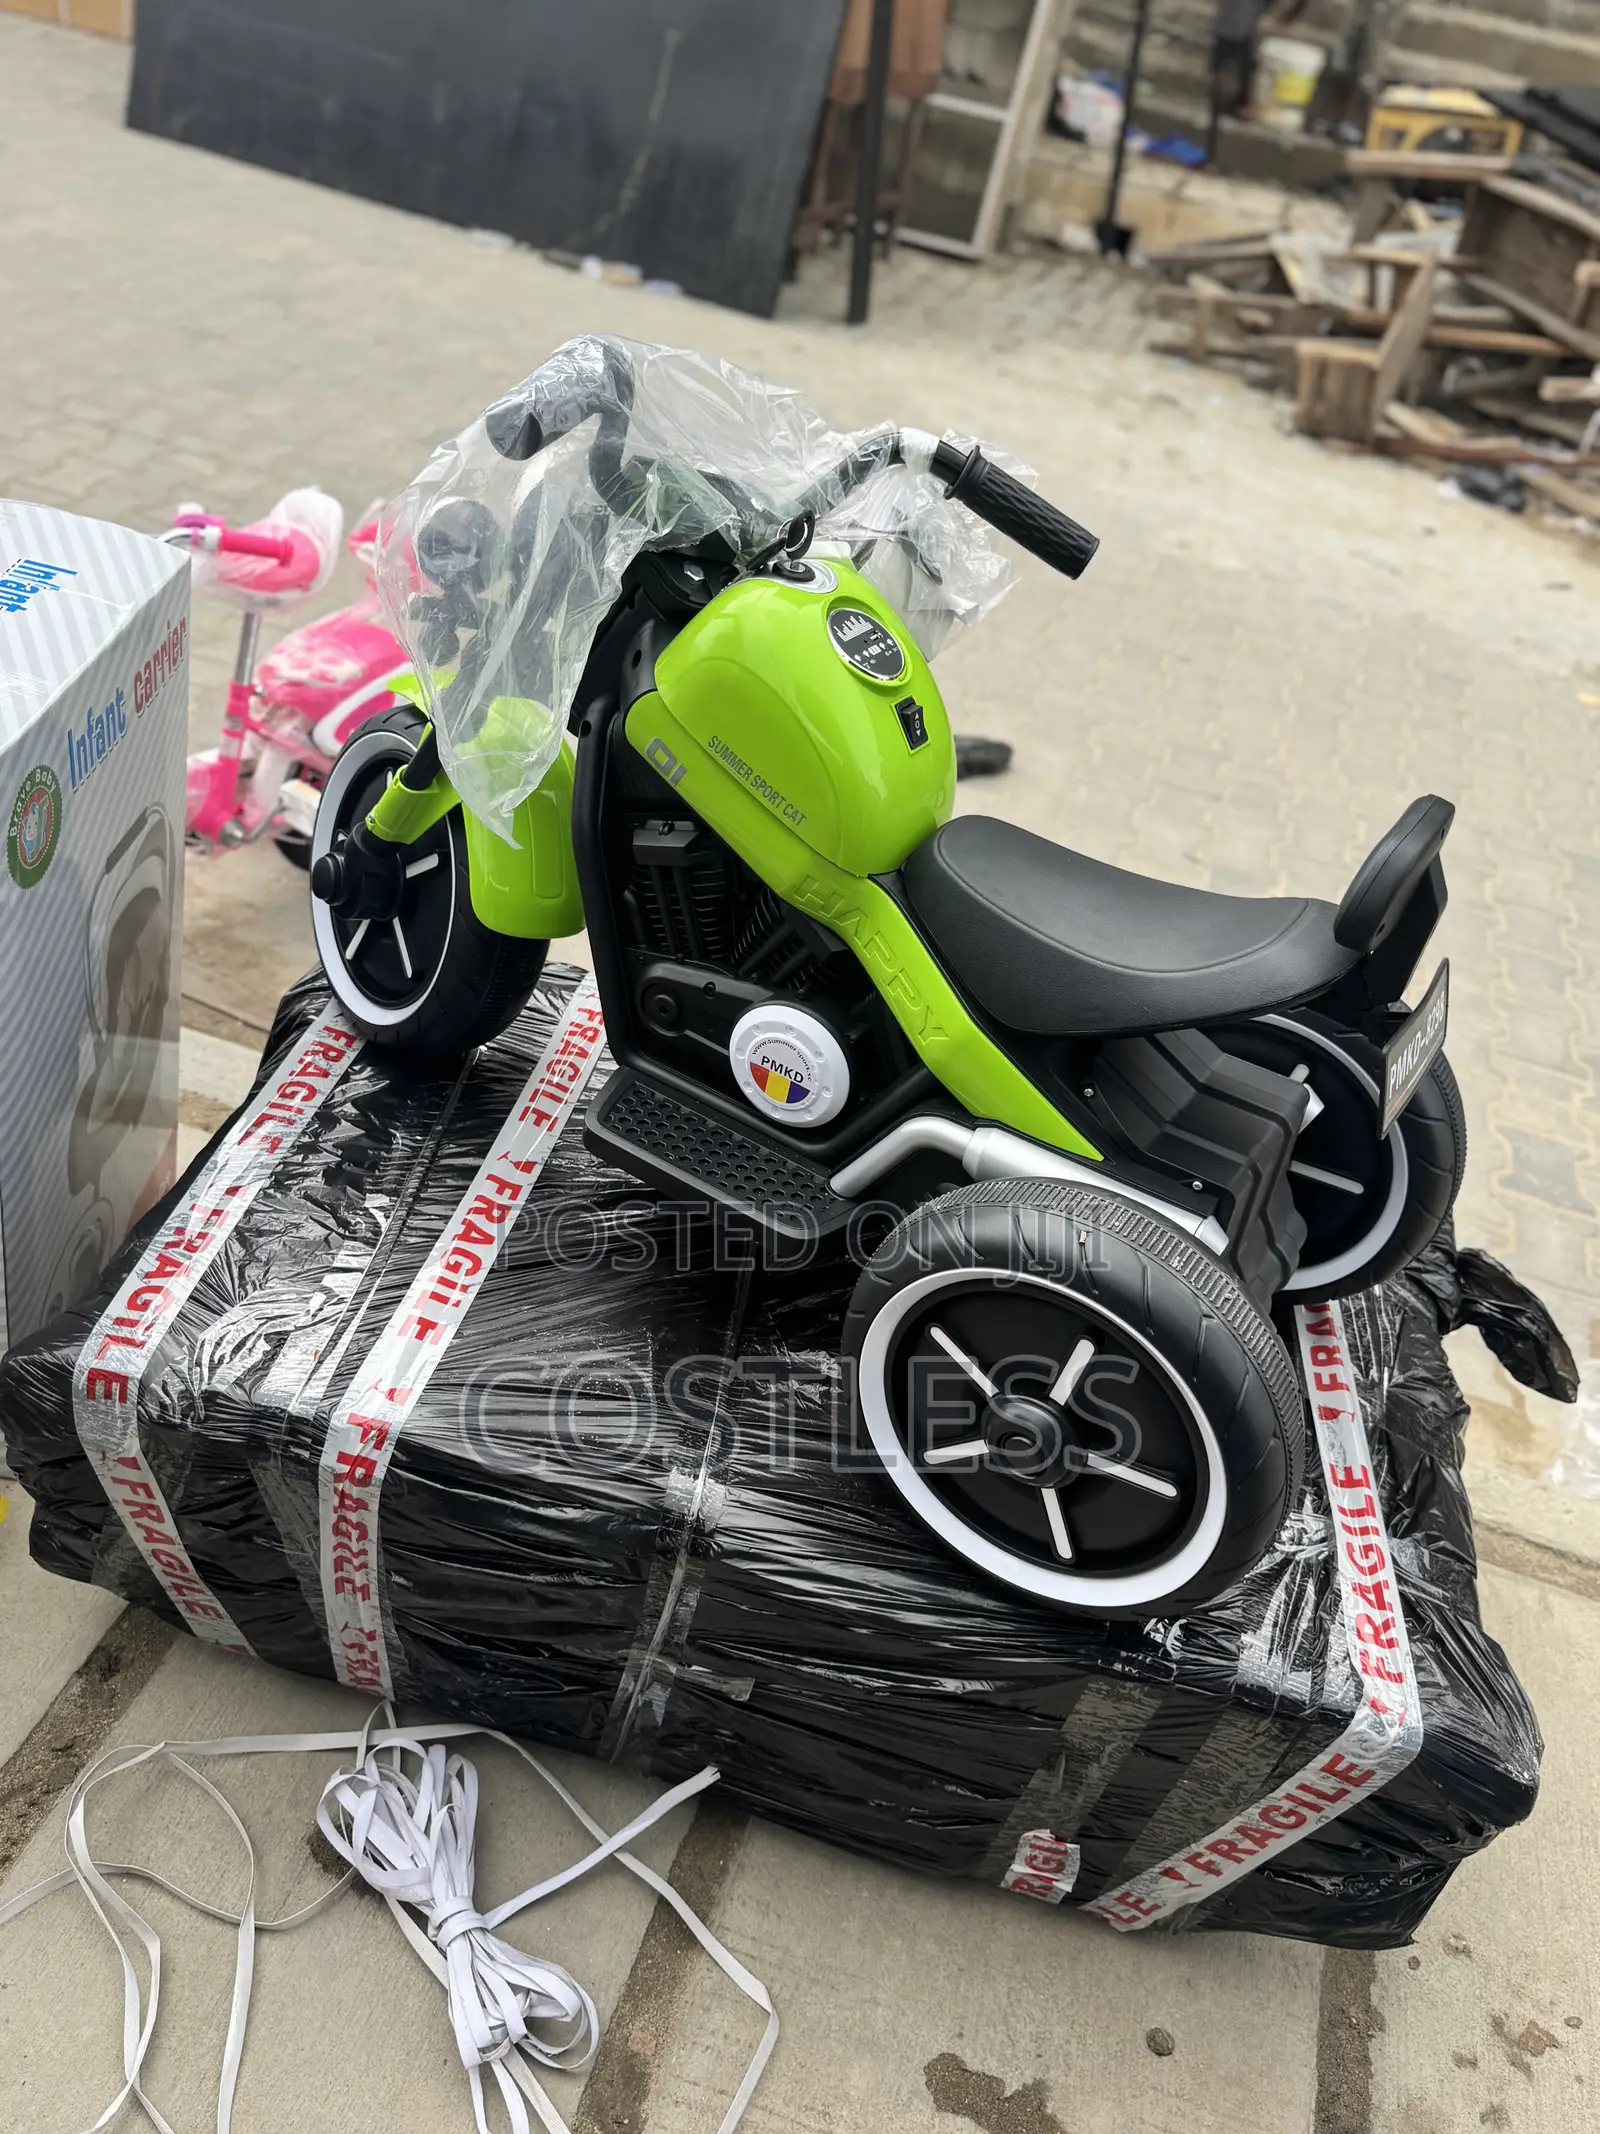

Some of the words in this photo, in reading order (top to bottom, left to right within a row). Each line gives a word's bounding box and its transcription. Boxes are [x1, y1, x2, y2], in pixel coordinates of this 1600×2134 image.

[67, 687, 127, 792] Infant
[134, 616, 187, 717] carrier
[10, 780, 32, 836] Brave
[36, 768, 56, 795] Baby
[708, 735, 753, 782] SUMMER
[751, 775, 786, 809] SPORT
[783, 803, 807, 826] CAT
[794, 875, 949, 1044] HAPPY
[239, 1025, 356, 1156] FRAGILE
[518, 1008, 605, 1133] FRAGILE
[761, 1055, 804, 1084] PMKD
[86, 1203, 228, 1404] FRAGILE
[397, 1173, 523, 1346] FRAGILE
[111, 1475, 224, 1621] FRAGILE
[1329, 1464, 1406, 1685] FRAGILE
[1184, 1753, 1376, 1878] FRAGILE
